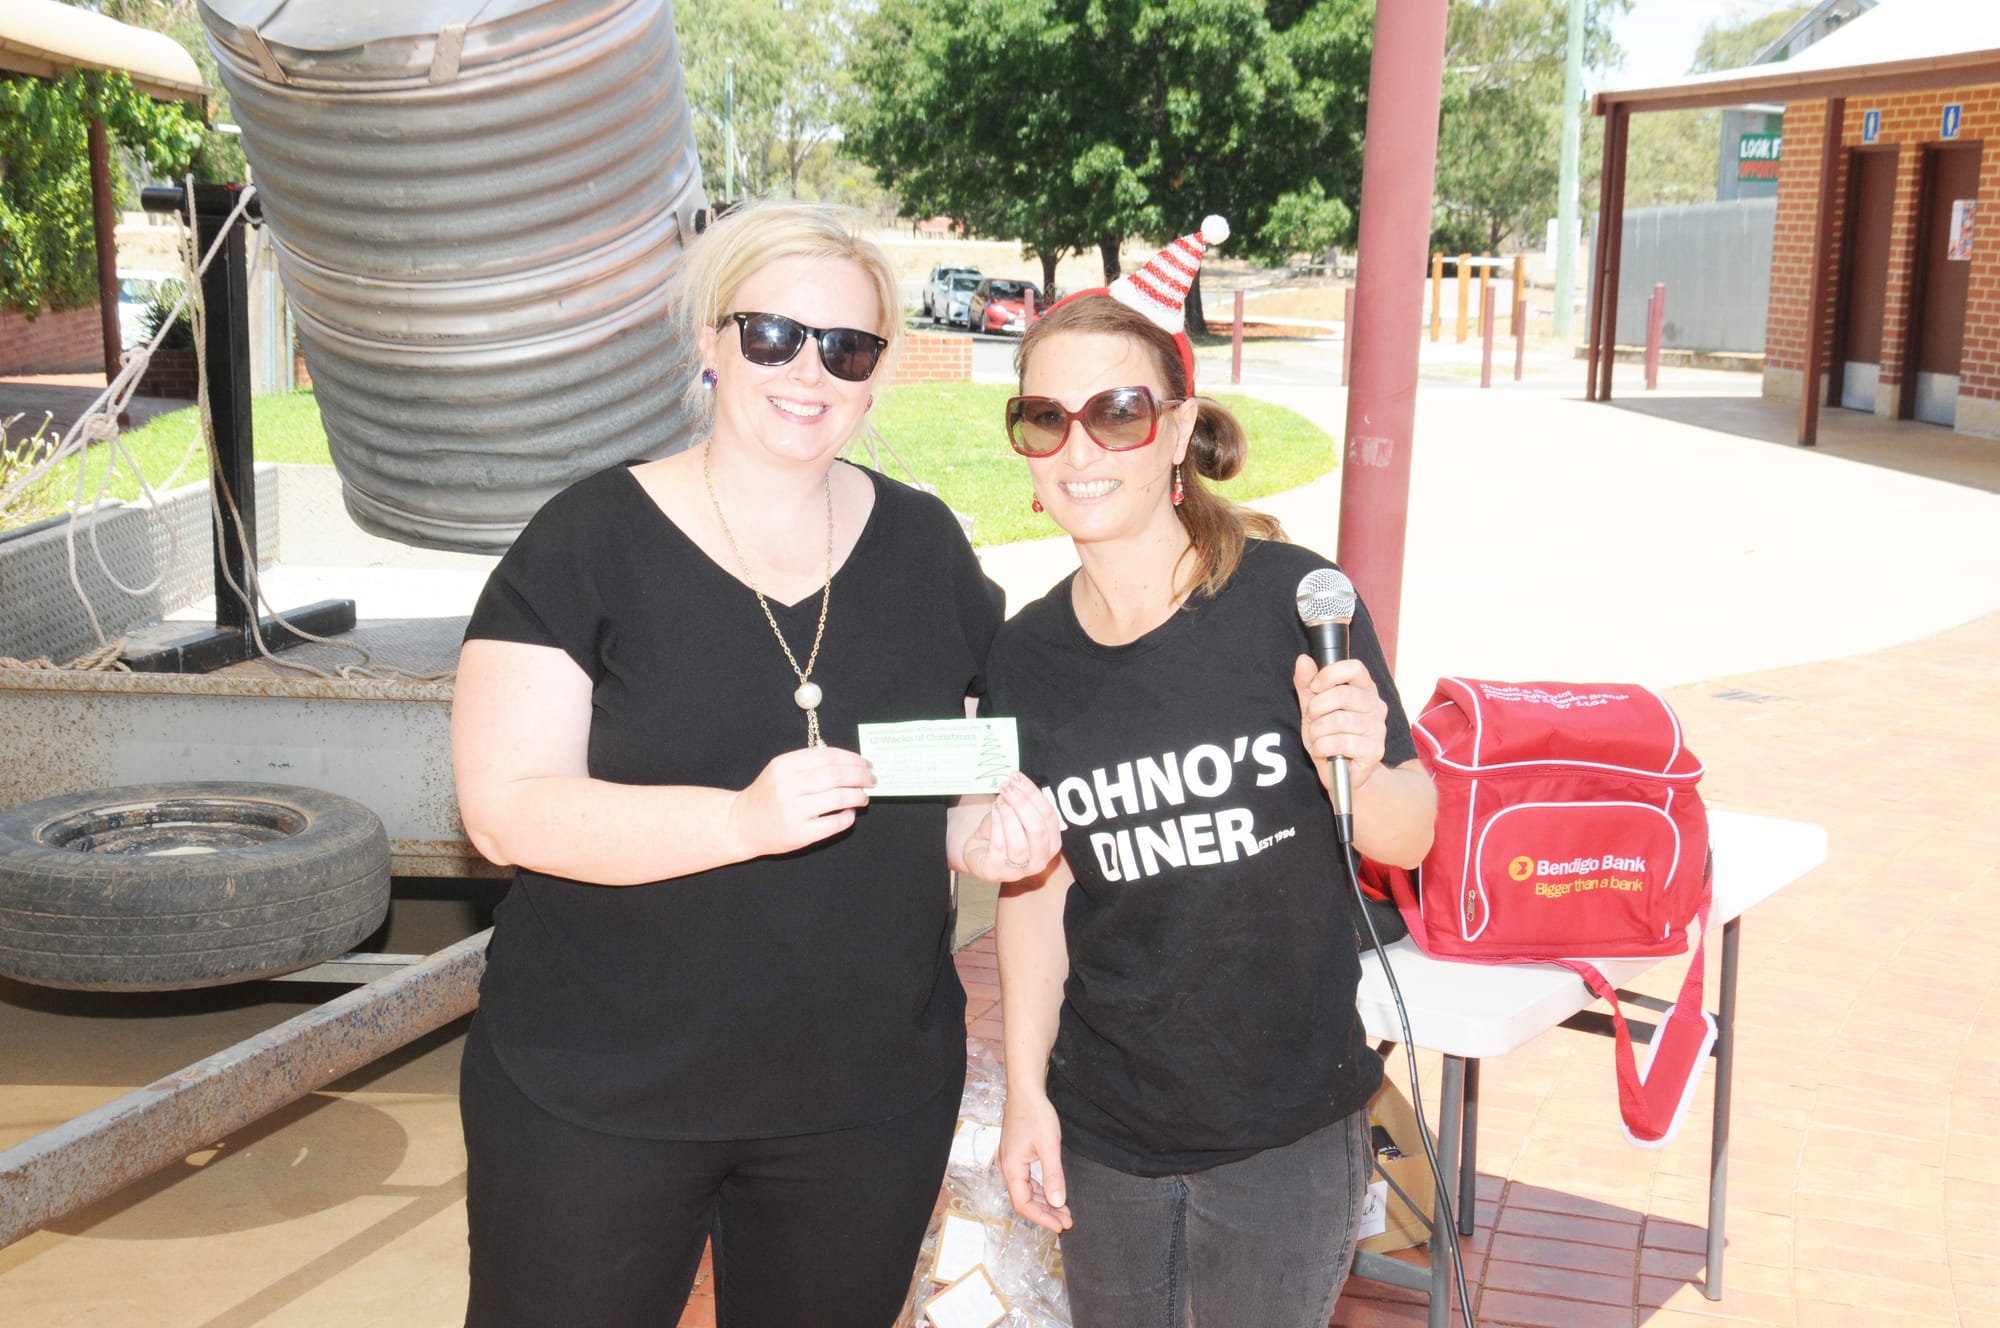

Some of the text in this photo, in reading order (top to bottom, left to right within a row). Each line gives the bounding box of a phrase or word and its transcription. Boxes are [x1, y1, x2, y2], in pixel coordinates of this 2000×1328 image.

[1740, 138, 1770, 159] LOOK
[926, 732, 977, 742] Christmas
[1089, 808, 1261, 883] DINER
[1536, 855, 1646, 876] Bendigo Bank
[1535, 876, 1643, 898] Bigger than a bank
